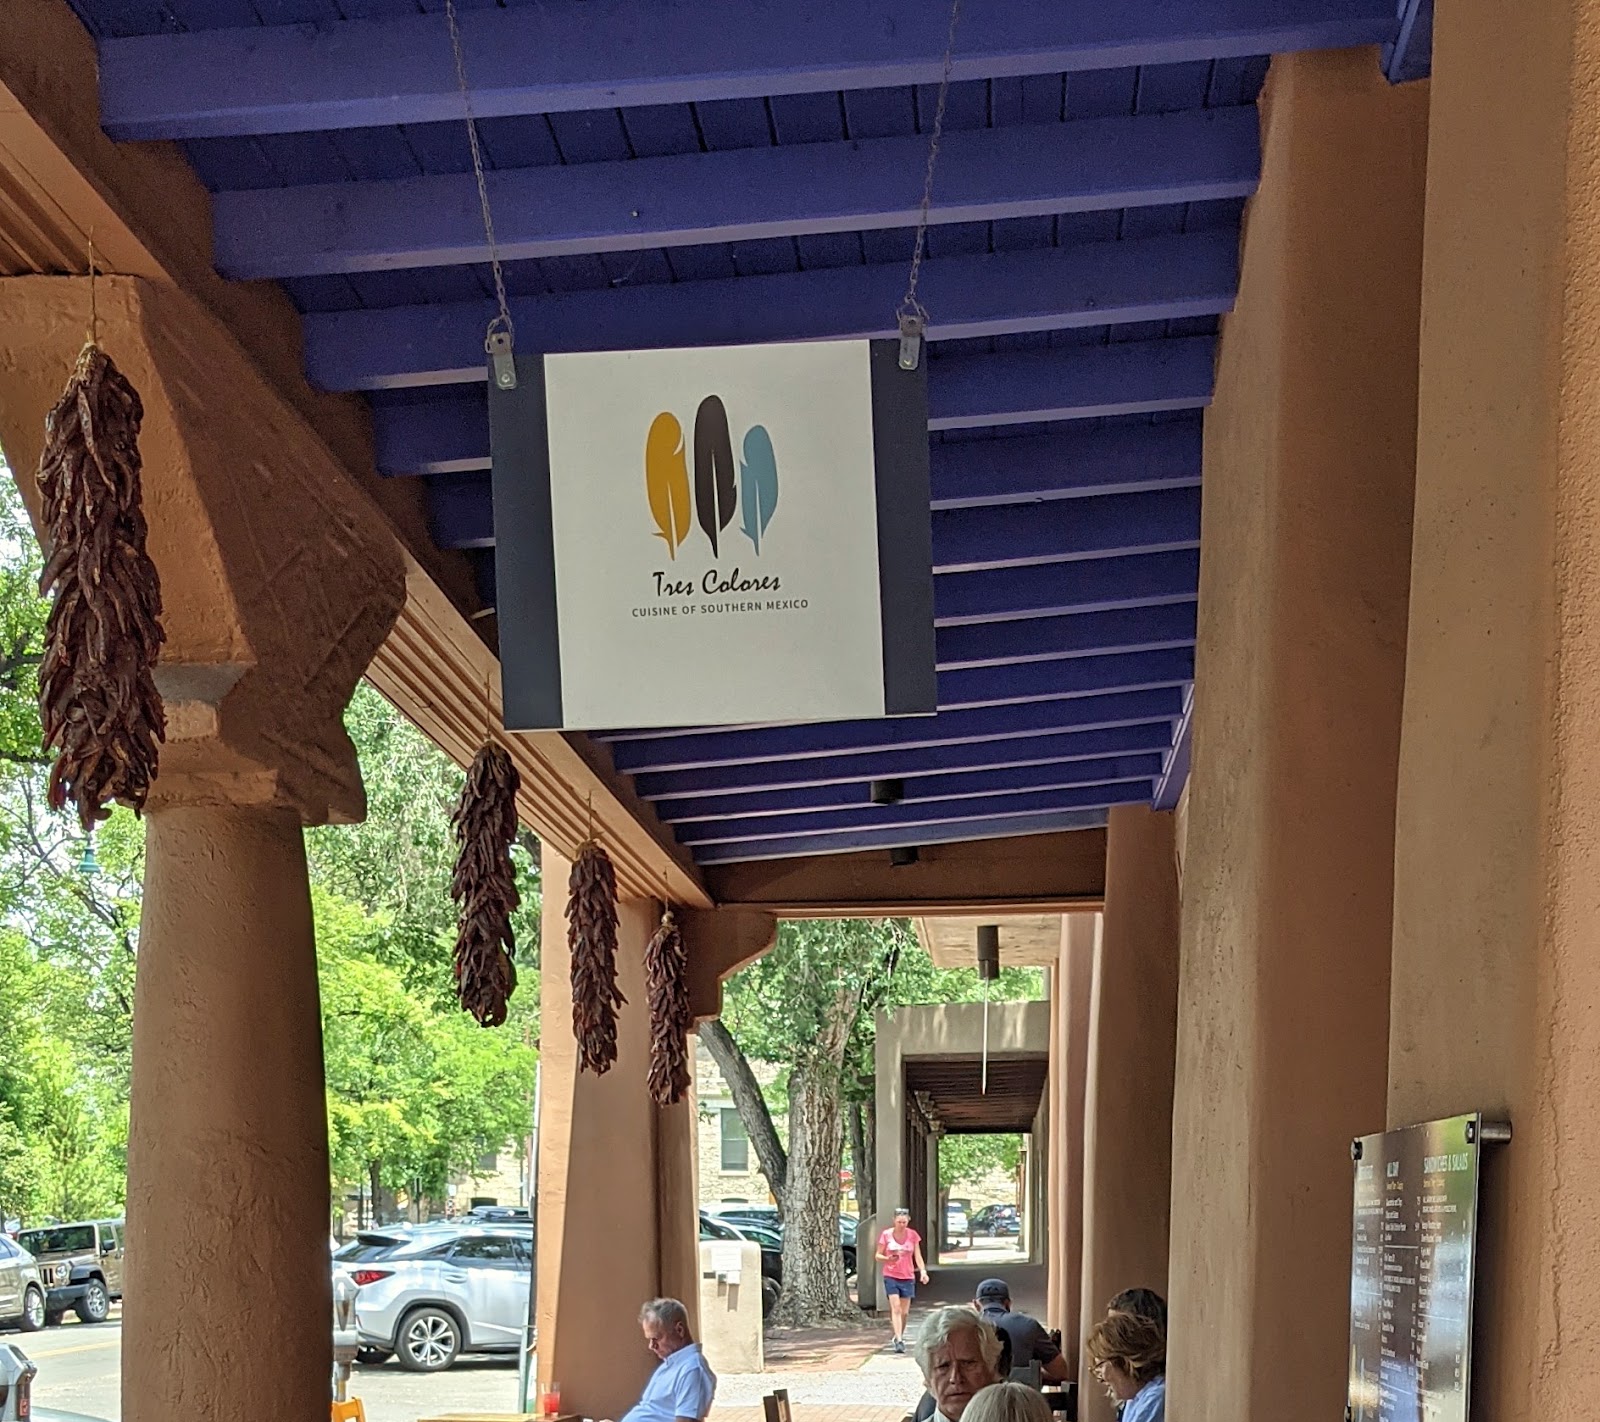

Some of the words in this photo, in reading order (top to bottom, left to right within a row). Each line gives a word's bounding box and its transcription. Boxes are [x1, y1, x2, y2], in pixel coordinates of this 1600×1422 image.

[652, 571, 694, 597] Tres
[702, 567, 780, 595] Colores
[632, 606, 677, 617] CUISINE
[682, 605, 696, 615] OF
[700, 602, 762, 614] SOUTHERN
[766, 599, 809, 610] MEXICO
